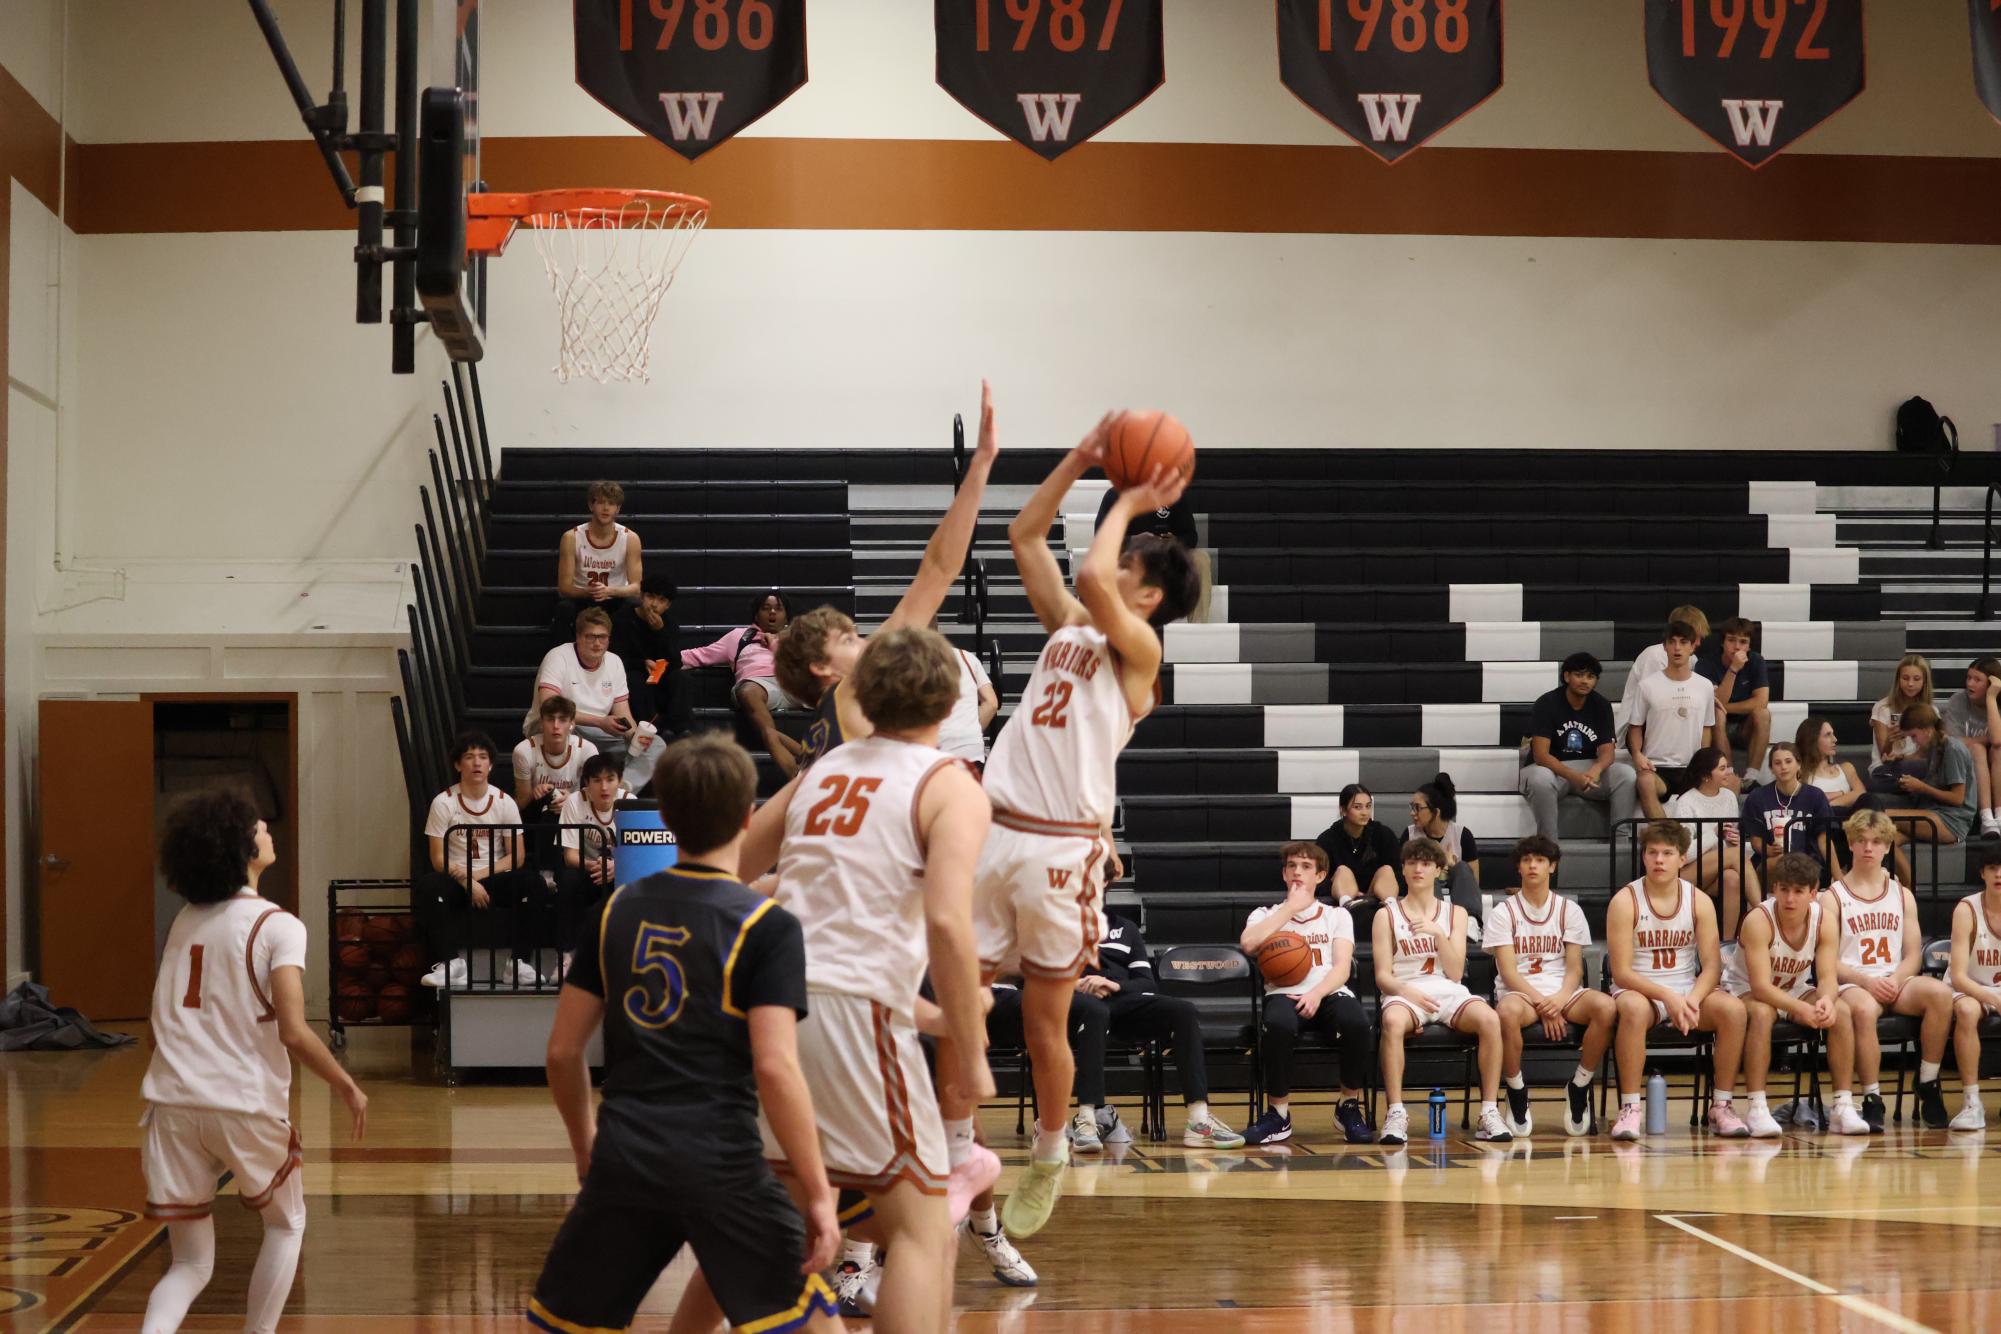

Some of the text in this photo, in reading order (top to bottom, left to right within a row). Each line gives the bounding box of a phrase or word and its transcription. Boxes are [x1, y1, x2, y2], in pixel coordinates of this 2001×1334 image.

[619, 0, 774, 51] 1986
[1318, 0, 1469, 53] 1988
[1681, 0, 1831, 60] 1992
[658, 91, 725, 141] W
[1016, 93, 1081, 142] W
[1357, 93, 1422, 142] W
[1721, 99, 1784, 147] W
[1031, 681, 1074, 729] 22
[803, 773, 884, 838] 25
[623, 831, 676, 845] POWER
[1047, 867, 1073, 890] W
[1514, 935, 1563, 954] WARRIORS
[1637, 929, 1693, 948] WARRIORS
[1848, 912, 1900, 935] WARRIORS
[1528, 955, 1544, 975] 3
[1652, 948, 1677, 970] 10
[1860, 936, 1892, 965] 24
[183, 944, 204, 1009] 1
[623, 920, 692, 1030] 5
